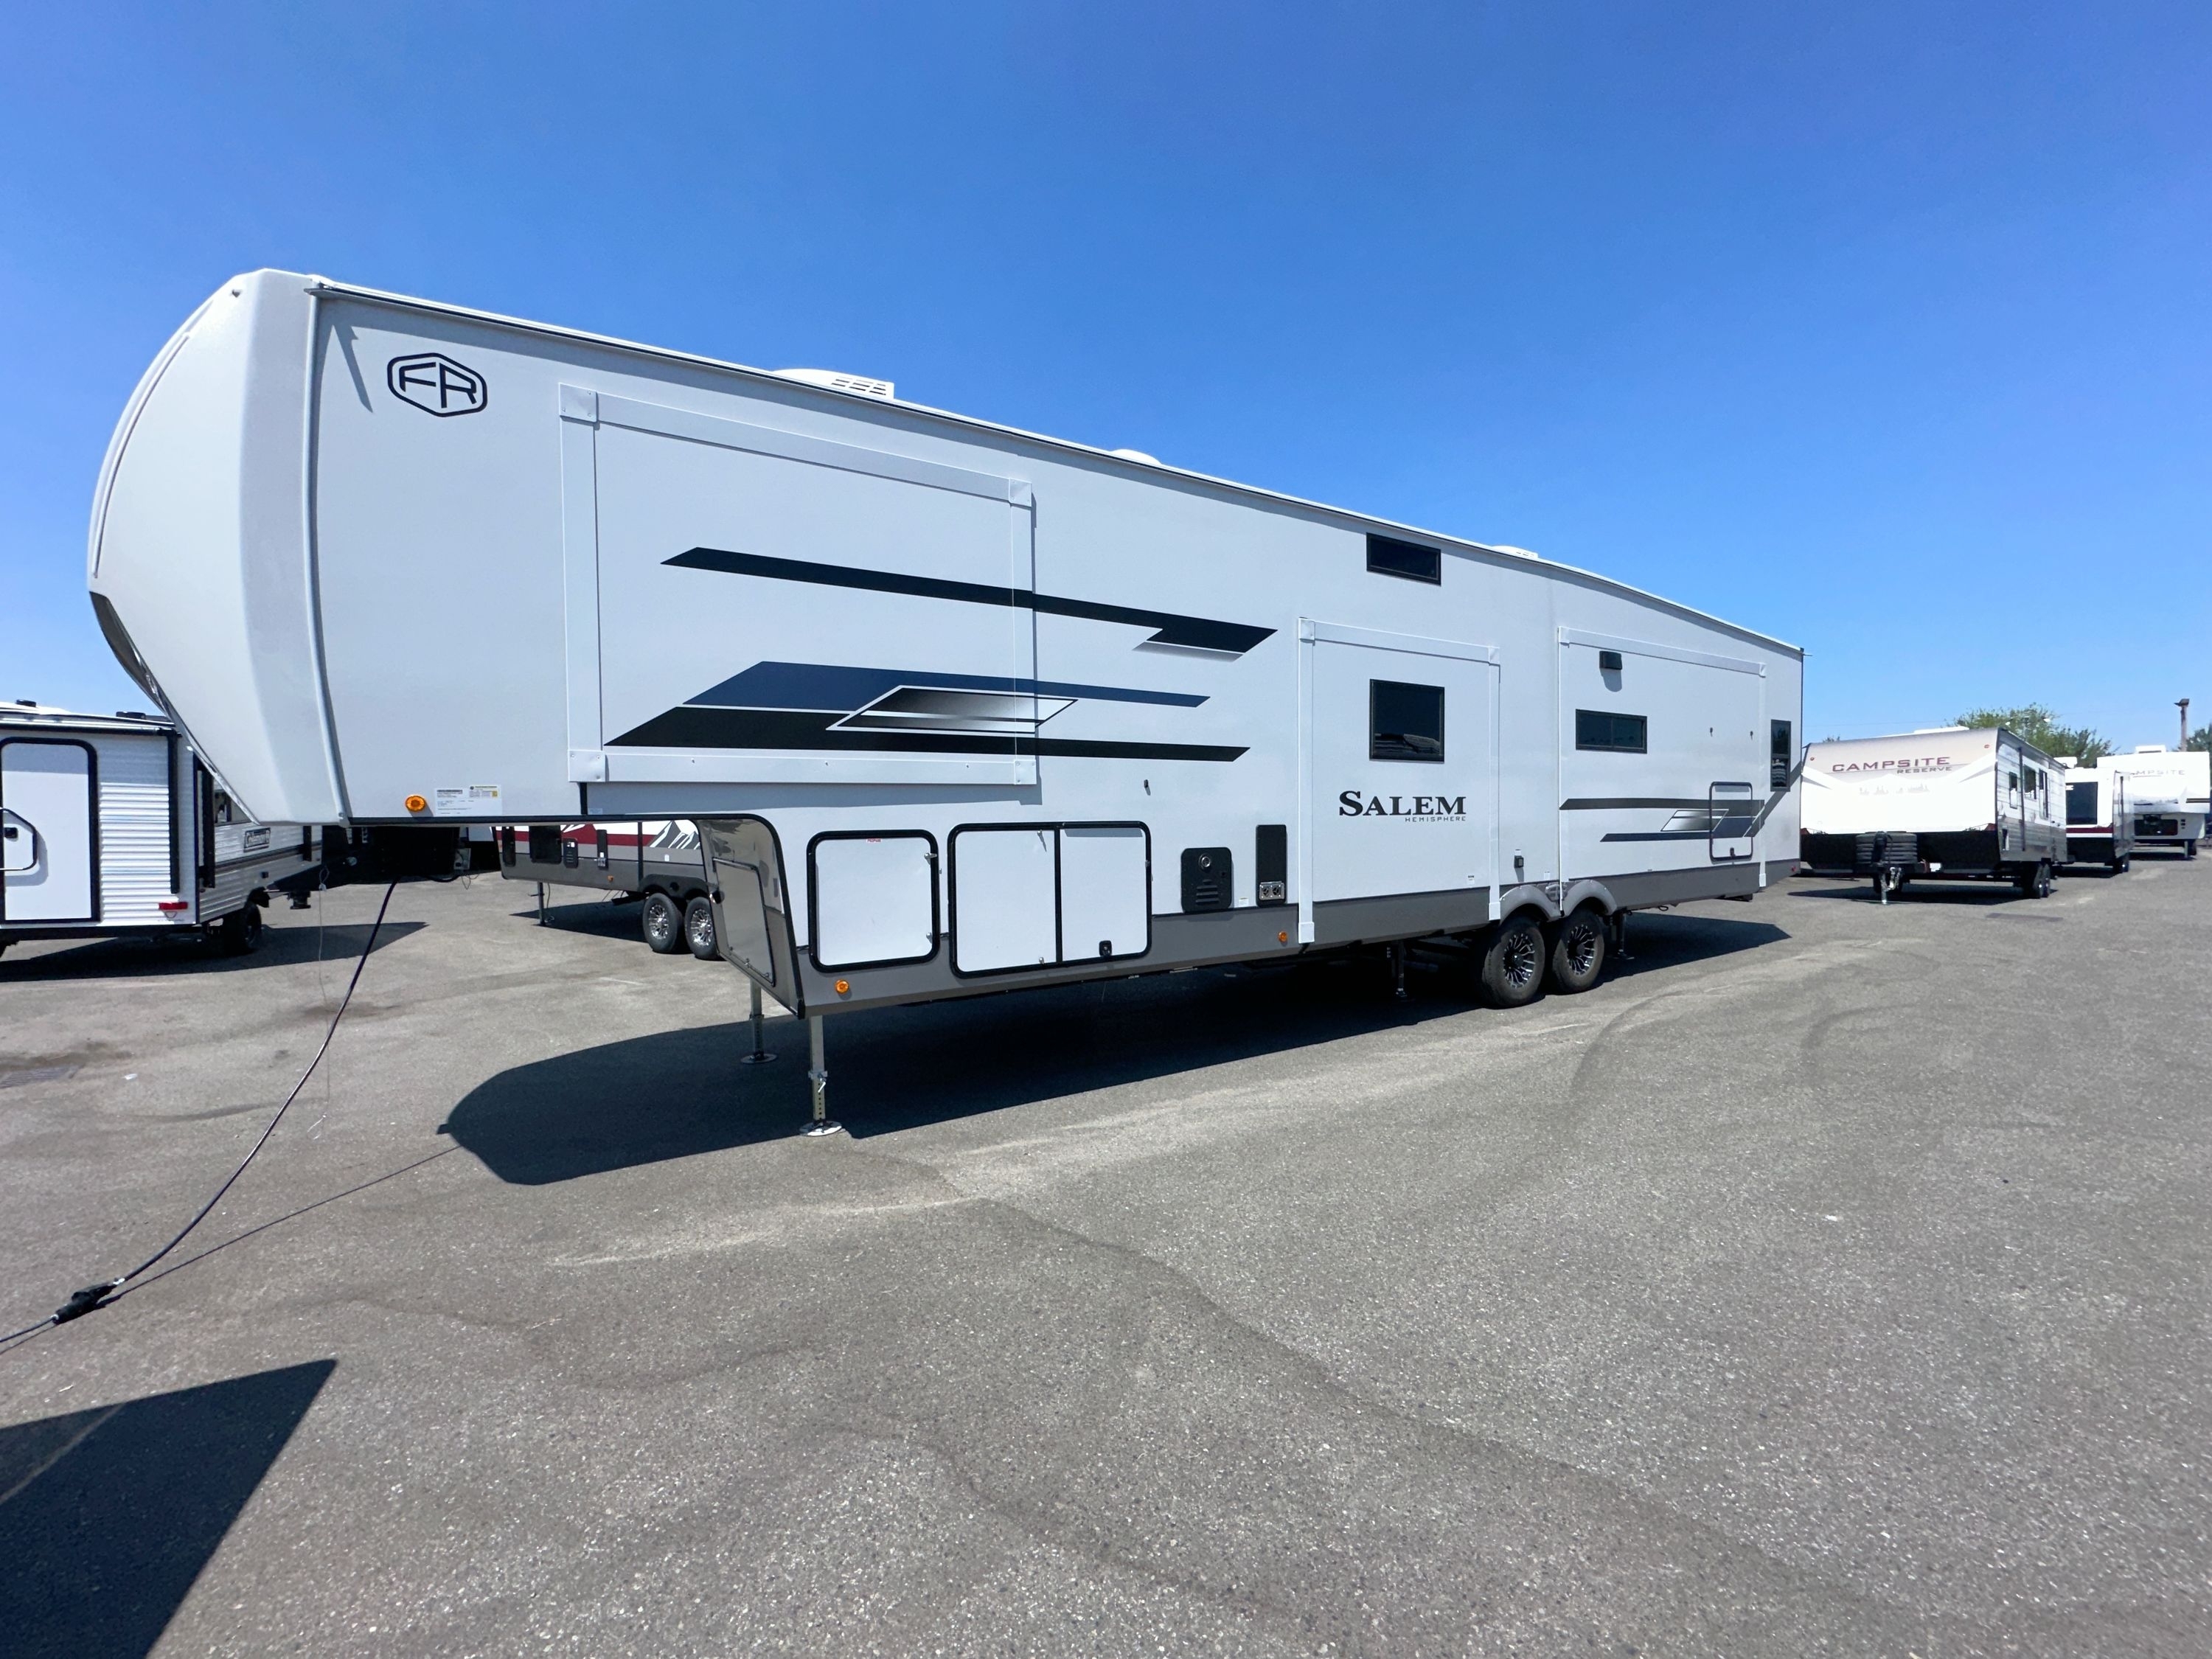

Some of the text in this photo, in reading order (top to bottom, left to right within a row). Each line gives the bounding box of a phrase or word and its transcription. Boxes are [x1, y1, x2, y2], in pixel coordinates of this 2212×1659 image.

[399, 361, 477, 408] FR
[1832, 757, 1951, 773] CAMPSITE
[1896, 766, 1953, 775] RESERVE
[1339, 790, 1467, 817] SALEM
